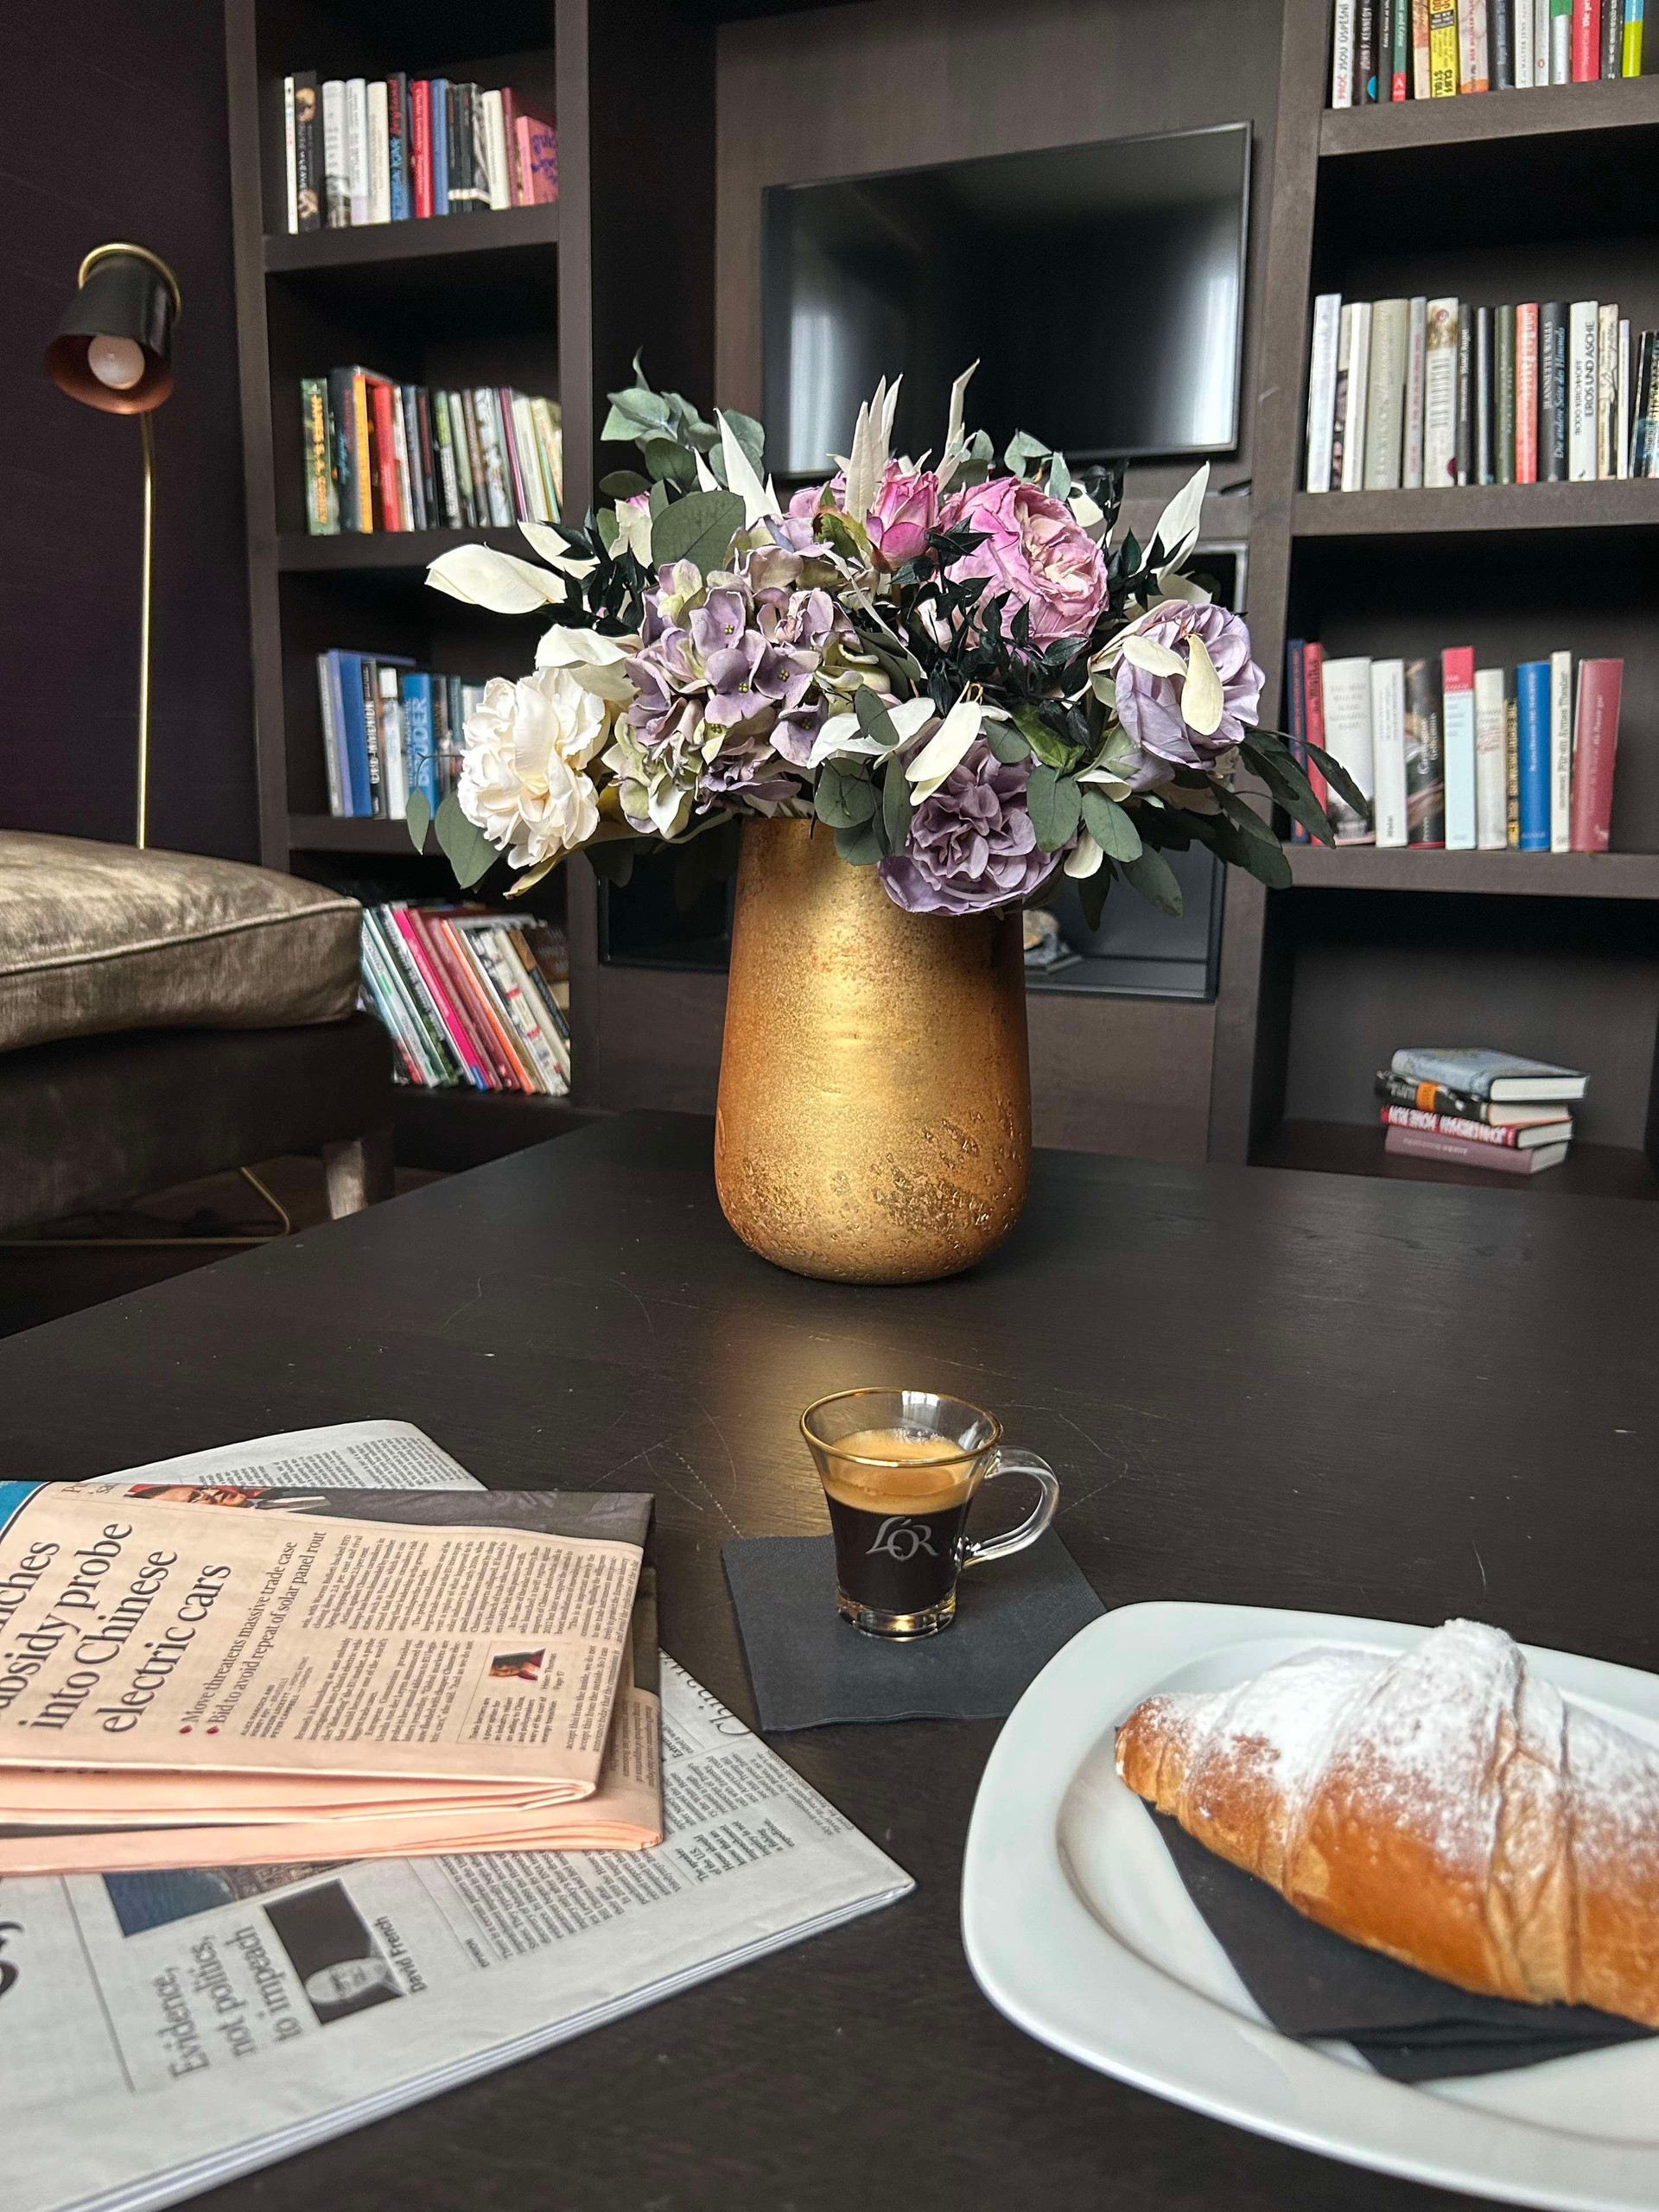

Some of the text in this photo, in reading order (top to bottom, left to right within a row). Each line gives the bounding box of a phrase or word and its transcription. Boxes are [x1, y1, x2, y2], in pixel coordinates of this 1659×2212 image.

[1361, 7, 1371, 41] KENNEDY
[1361, 49, 1371, 70] JOHN
[1585, 321, 1595, 417] EROS UND ASCHE
[1574, 409, 1583, 435] BODO
[54, 1522, 133, 1611] probe
[18, 1670, 101, 1730] into
[74, 1550, 178, 1664] Chinese
[180, 1541, 298, 1722] Move threatens massive trade case
[207, 1532, 327, 1723] Bid to avoid repeat of solar panel rout
[95, 1565, 232, 1733] electric cars
[540, 1652, 556, 1688] Helen Thomas
[715, 1838, 730, 1849] that
[719, 1824, 759, 1860] impeachment
[732, 1821, 745, 1830] not
[756, 1827, 777, 1847] fishing
[693, 1834, 734, 1869] House should
[728, 1849, 747, 1864] know
[748, 1834, 771, 1855] inquiry
[674, 1847, 709, 1879] The speaker
[701, 1859, 715, 1868] the
[375, 1916, 429, 1994] David French
[188, 1935, 257, 2057] not politics,
[226, 1924, 303, 2044] to impeach
[153, 1965, 211, 2078] Evidence,
